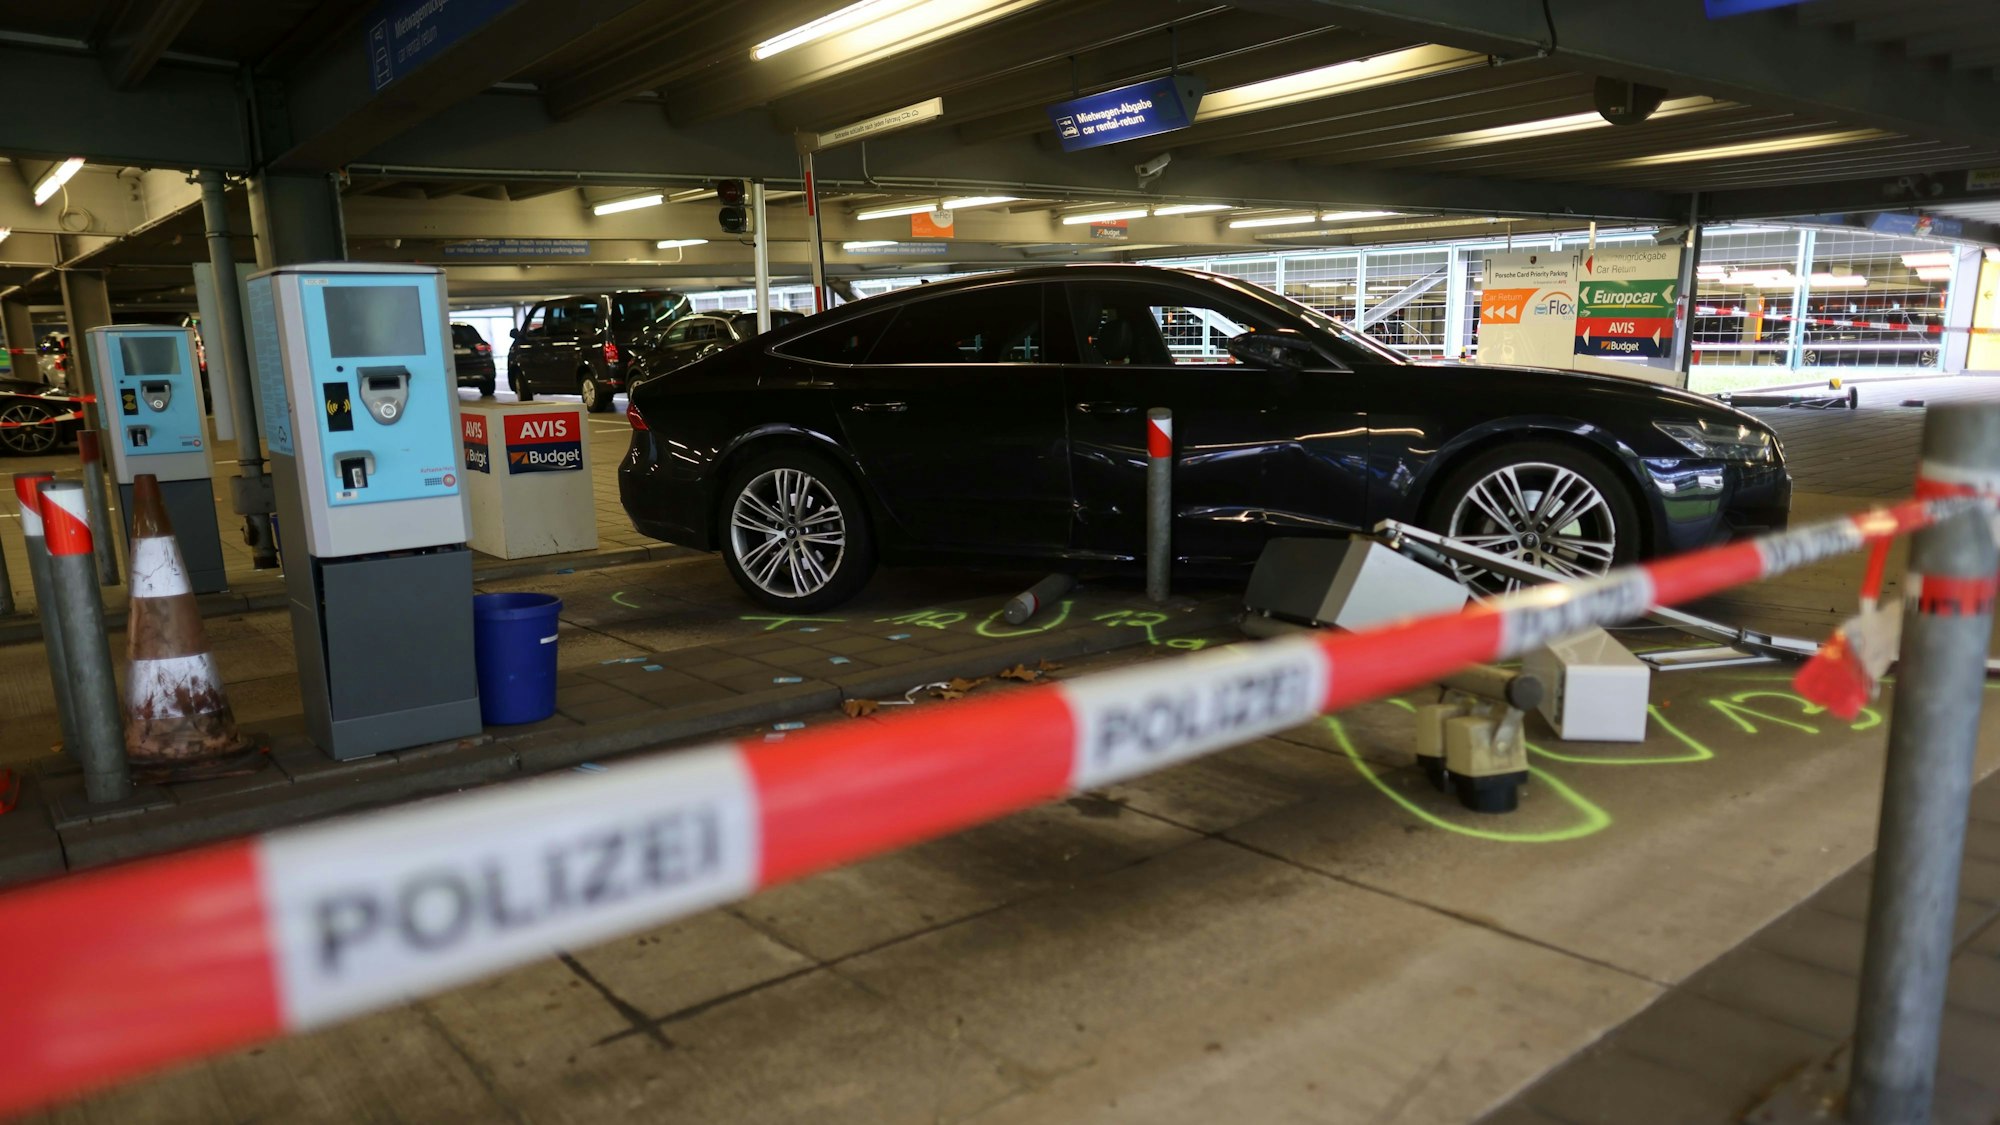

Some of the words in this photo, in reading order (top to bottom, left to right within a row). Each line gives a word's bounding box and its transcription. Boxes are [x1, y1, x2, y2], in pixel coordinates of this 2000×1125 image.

[1075, 99, 1152, 123] Mietwagen-Abgabe
[1082, 125, 1095, 135] car
[1096, 114, 1145, 132] rental-return
[1104, 229, 1120, 238] Budget
[1530, 271, 1549, 279] Priority
[1549, 270, 1568, 278] Parking
[1596, 265, 1609, 274] Car
[1611, 265, 1637, 274] Return
[1549, 300, 1575, 315] Flex
[1593, 290, 1658, 308] Europcar
[1608, 322, 1635, 334] AVIS
[1610, 341, 1640, 353] Budget
[465, 421, 482, 439] AVIS
[519, 419, 567, 439] AVIS
[529, 448, 580, 466] Budget
[1094, 662, 1315, 764] POLIZEI
[311, 806, 725, 978] POLIZEI
